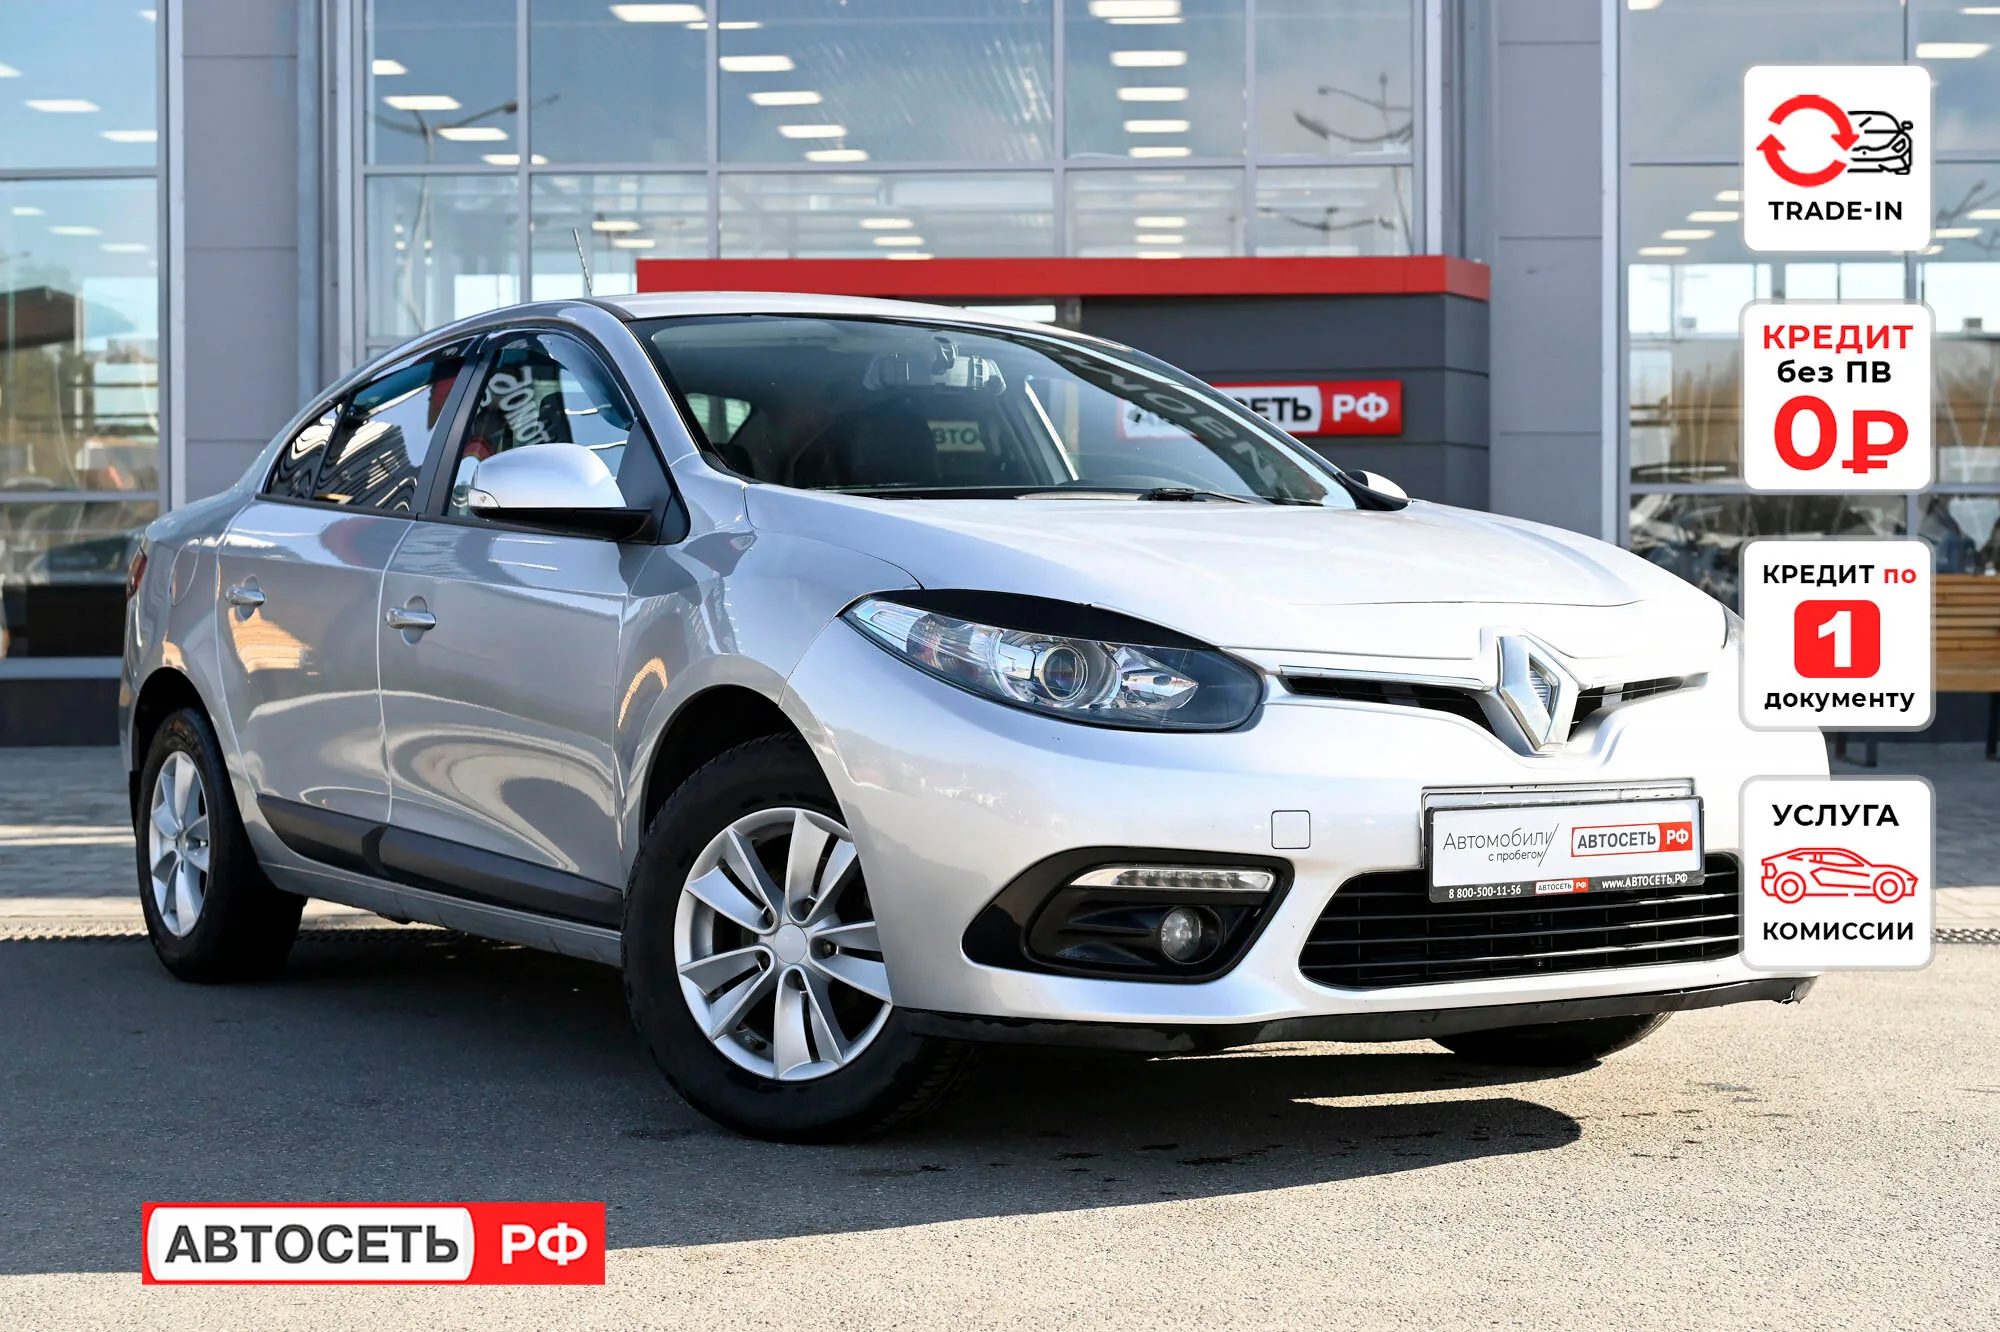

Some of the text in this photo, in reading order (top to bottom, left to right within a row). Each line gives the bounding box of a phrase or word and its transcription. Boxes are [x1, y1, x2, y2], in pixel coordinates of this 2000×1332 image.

[1332, 392, 1390, 422] РФ
[1577, 827, 1690, 849] АВТОСЕТЬ РФ
[1487, 852, 1495, 862] с
[1537, 880, 1587, 892] АВТОСЕТЬ РФ
[1601, 872, 1689, 889] www.АВТОСЕТЬ.РФ
[1448, 884, 1522, 899] 8 800-500-11-56
